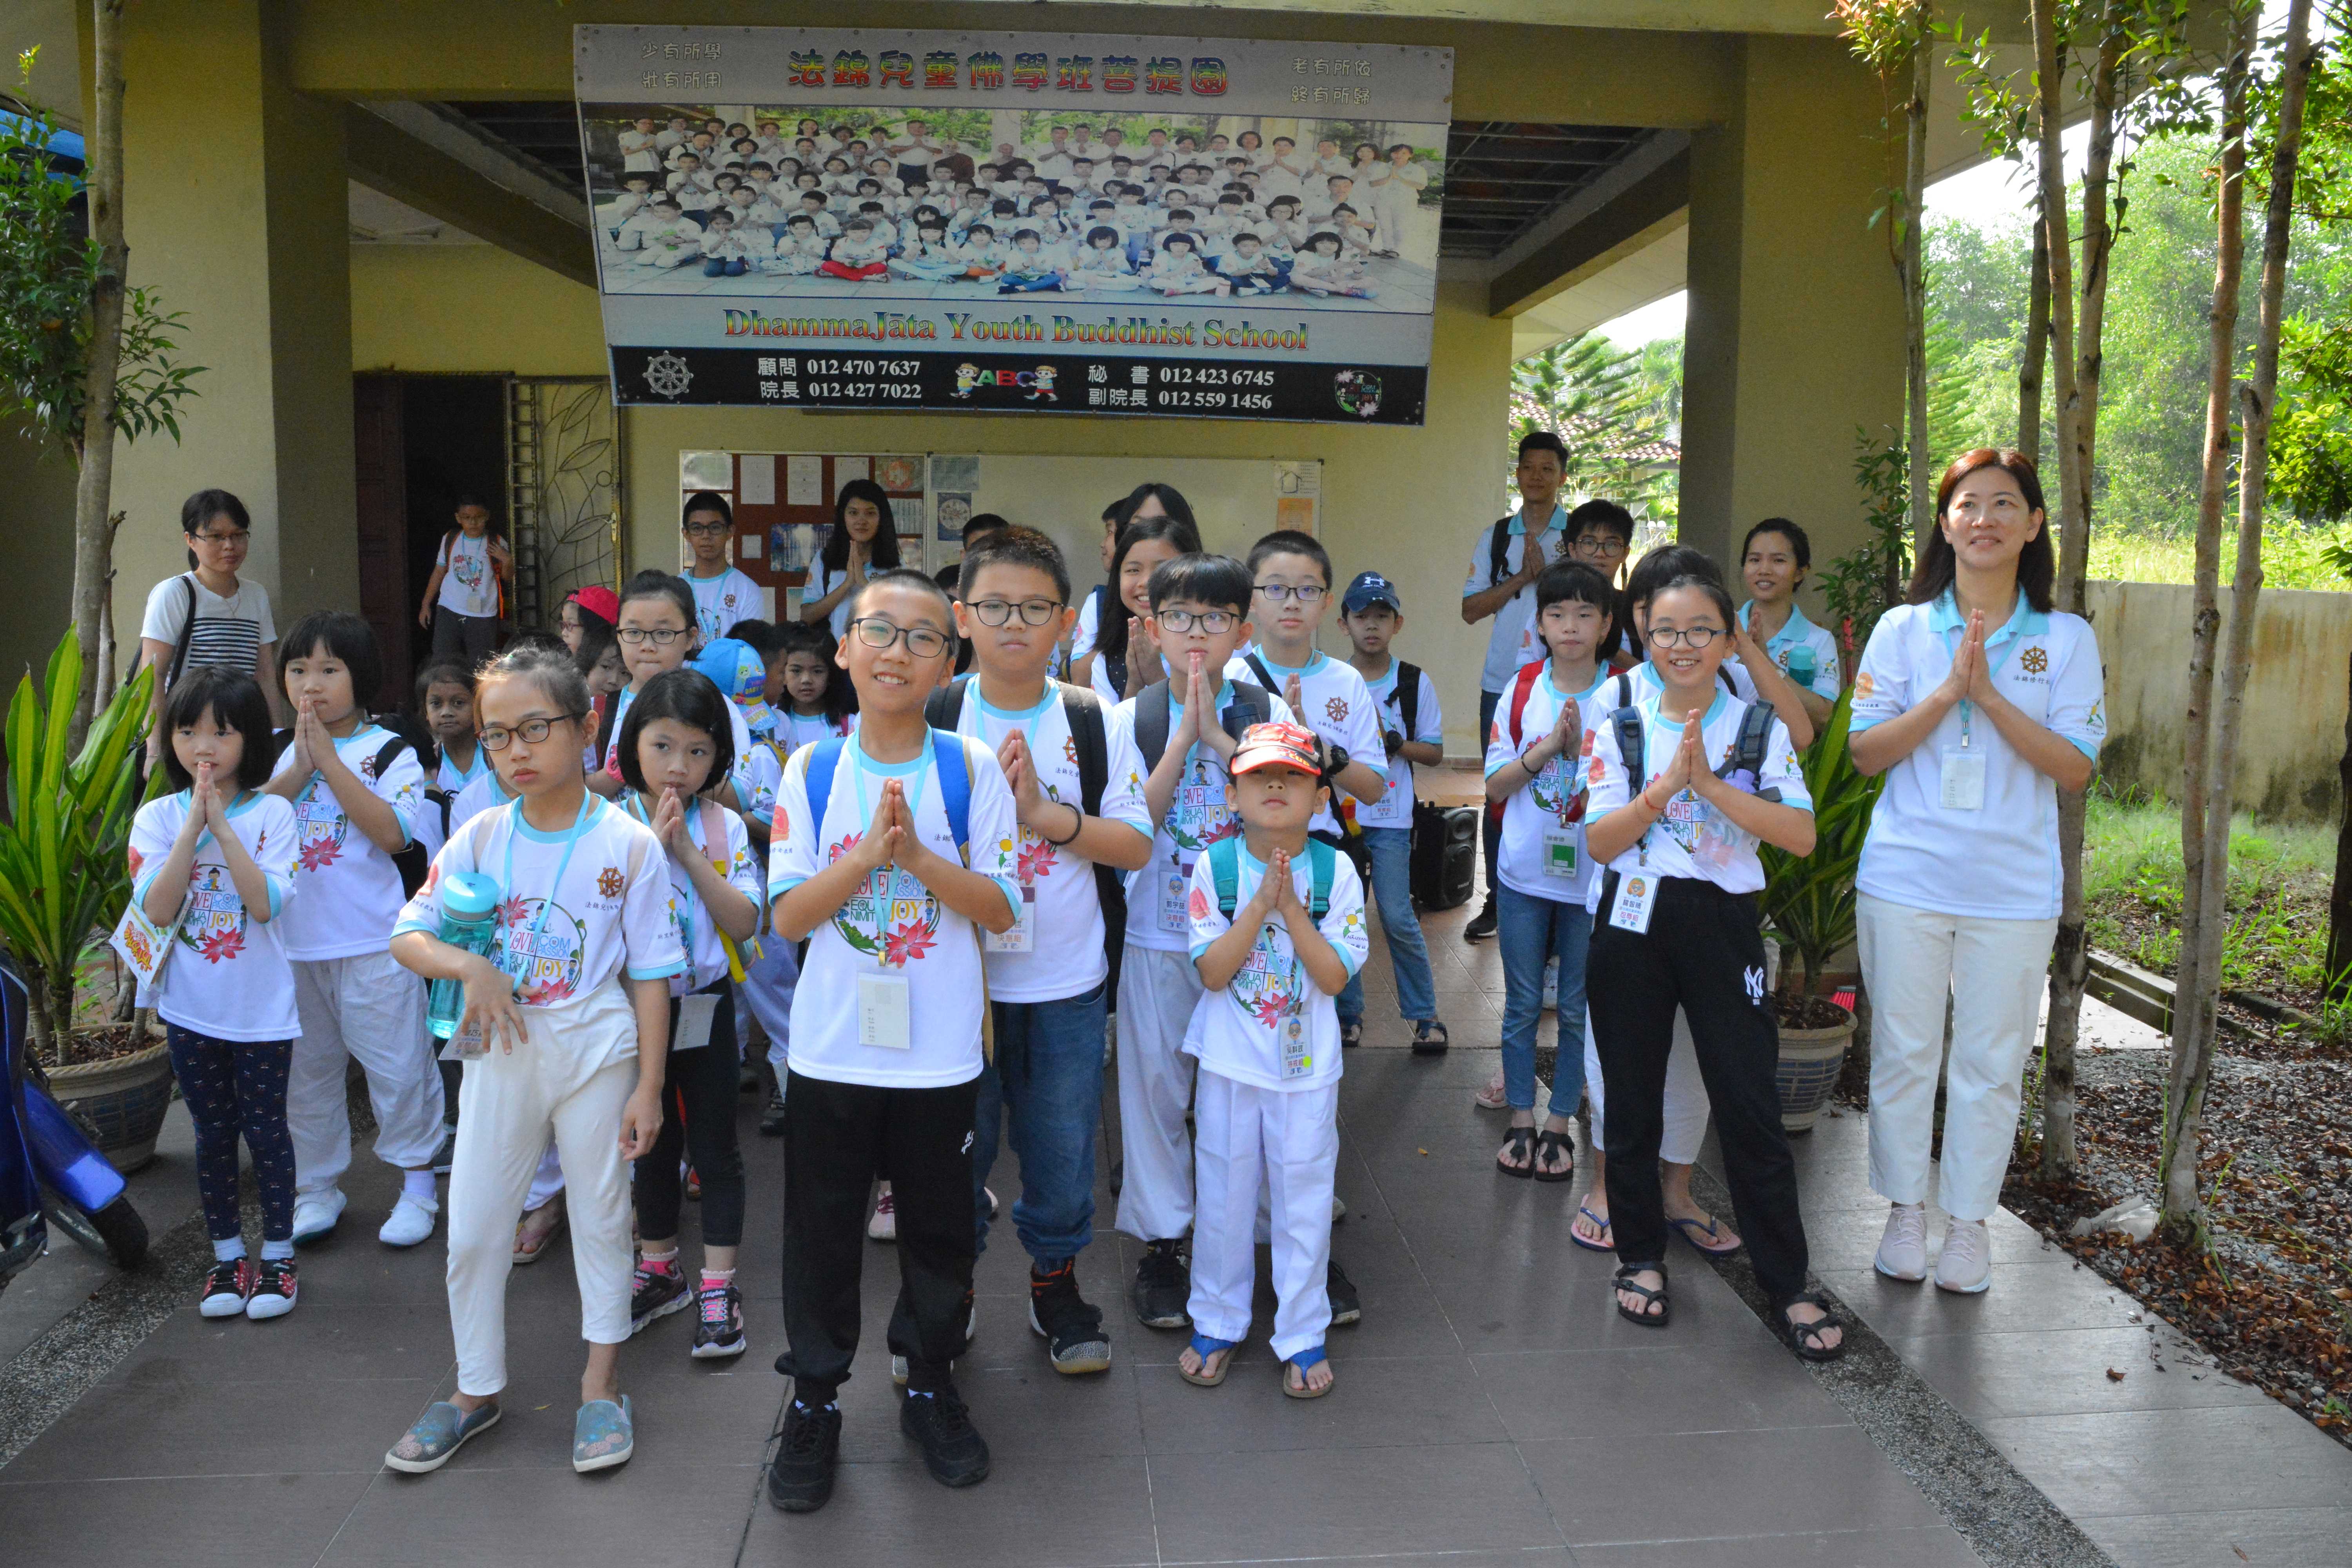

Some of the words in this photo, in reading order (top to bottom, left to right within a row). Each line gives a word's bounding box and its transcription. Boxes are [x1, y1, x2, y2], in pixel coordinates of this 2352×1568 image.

[642, 42, 722, 61] 少有所學
[788, 49, 1229, 95] 法錦兒童佛學班菩提園
[1292, 56, 1372, 78] 老有所依
[1291, 85, 1371, 106] 終有所歸
[944, 311, 1044, 343] Youth
[1051, 315, 1196, 347] Buddhist
[1202, 319, 1308, 351] School
[758, 358, 797, 377] 顧問
[807, 359, 840, 376] 012
[842, 359, 875, 376] 470
[878, 360, 920, 377] 7637
[976, 370, 1038, 387] ABC
[1160, 368, 1192, 384] 012
[1196, 368, 1228, 385] 423
[1231, 370, 1274, 387] 6745
[760, 380, 800, 399] 院長
[808, 381, 840, 397] 012
[843, 382, 875, 398] 427
[879, 383, 922, 399] 7022
[1088, 388, 1149, 408] 副院長
[1158, 390, 1191, 407] 012
[1193, 391, 1227, 408] 559
[1230, 392, 1273, 410] 1456
[310, 804, 336, 814] COM
[1666, 802, 1691, 820] LOVE
[306, 822, 332, 837] JOY
[214, 893, 241, 904] COM
[894, 886, 925, 898] ASSION
[209, 912, 238, 929] JOY
[851, 911, 875, 922] NIMIT
[889, 901, 924, 922] JOY
[539, 935, 571, 949] COM
[537, 946, 568, 958] PASSION
[533, 958, 567, 978] JOY
